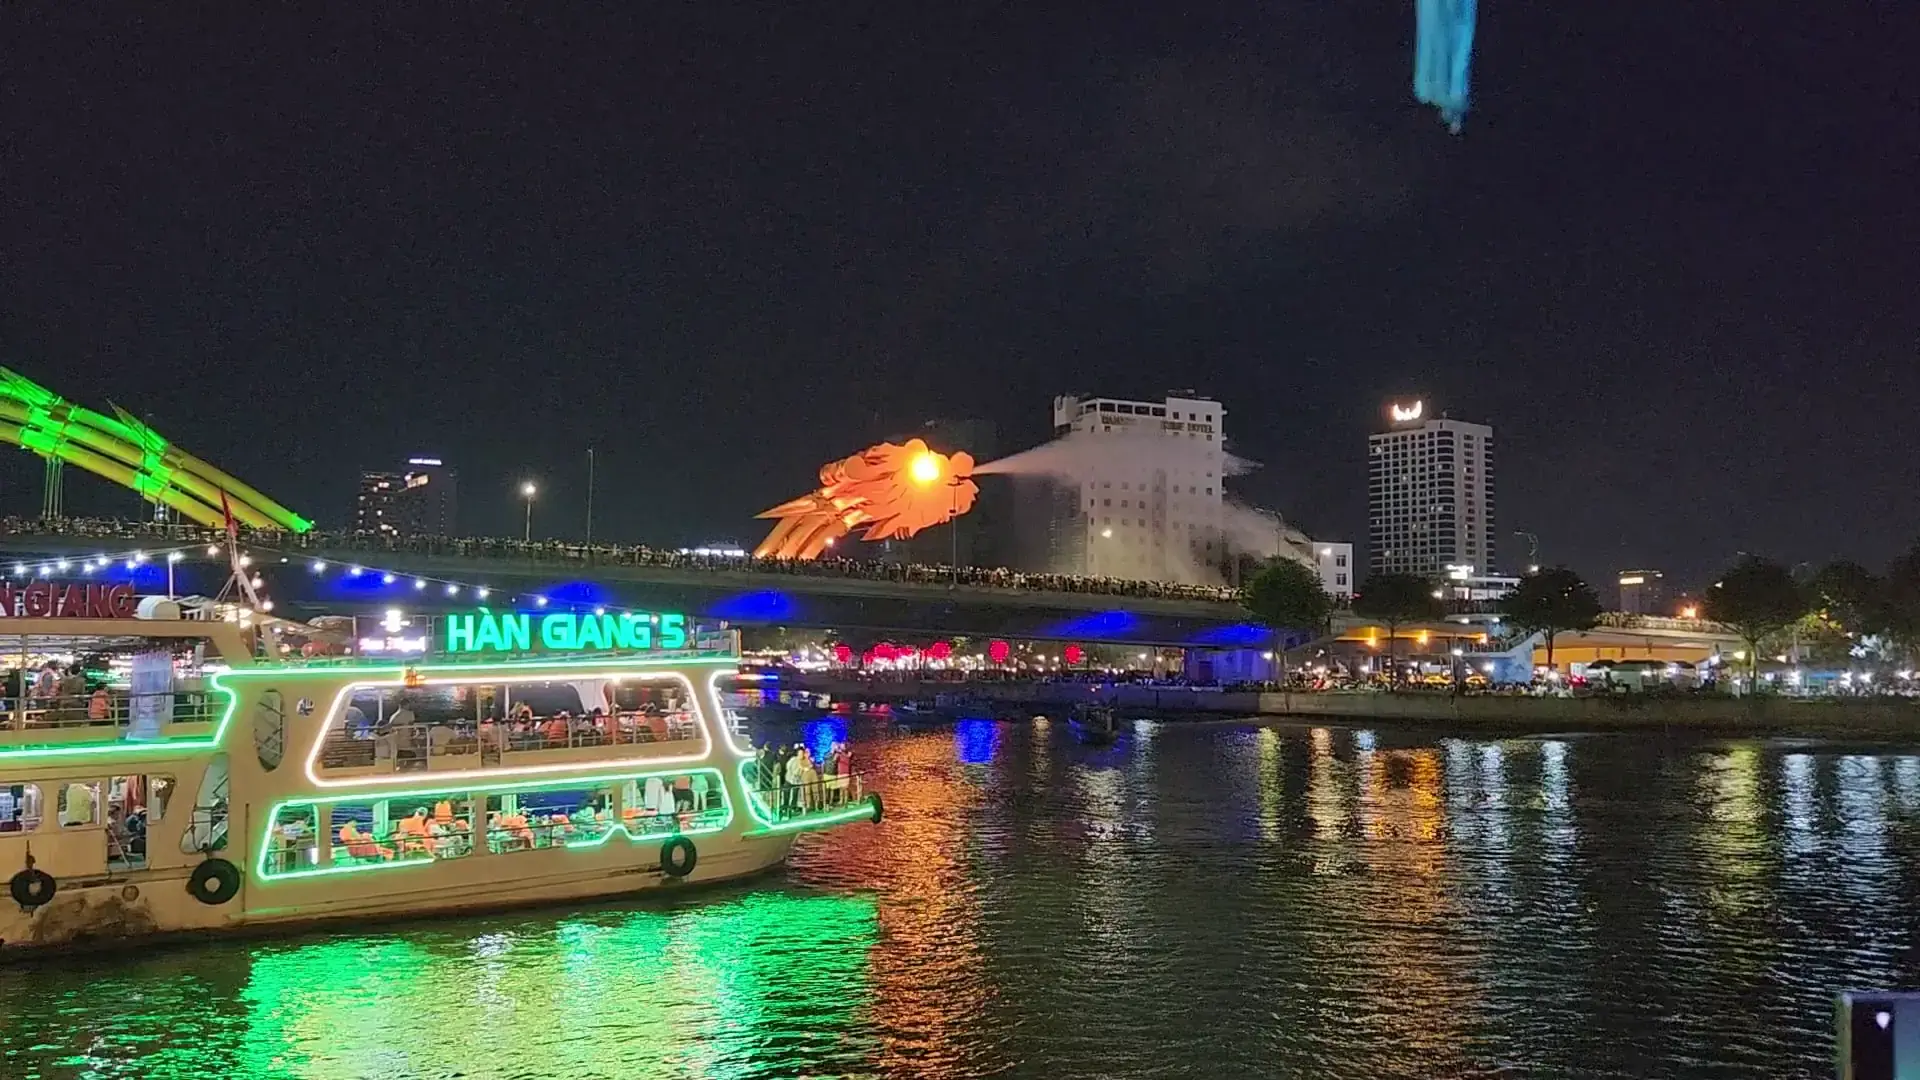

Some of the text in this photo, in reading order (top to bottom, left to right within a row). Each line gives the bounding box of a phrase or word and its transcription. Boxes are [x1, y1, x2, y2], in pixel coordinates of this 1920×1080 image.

[25, 581, 134, 617] GIANG
[448, 607, 530, 650] HÀN
[542, 613, 650, 649] GIANG
[660, 613, 685, 649] 5
